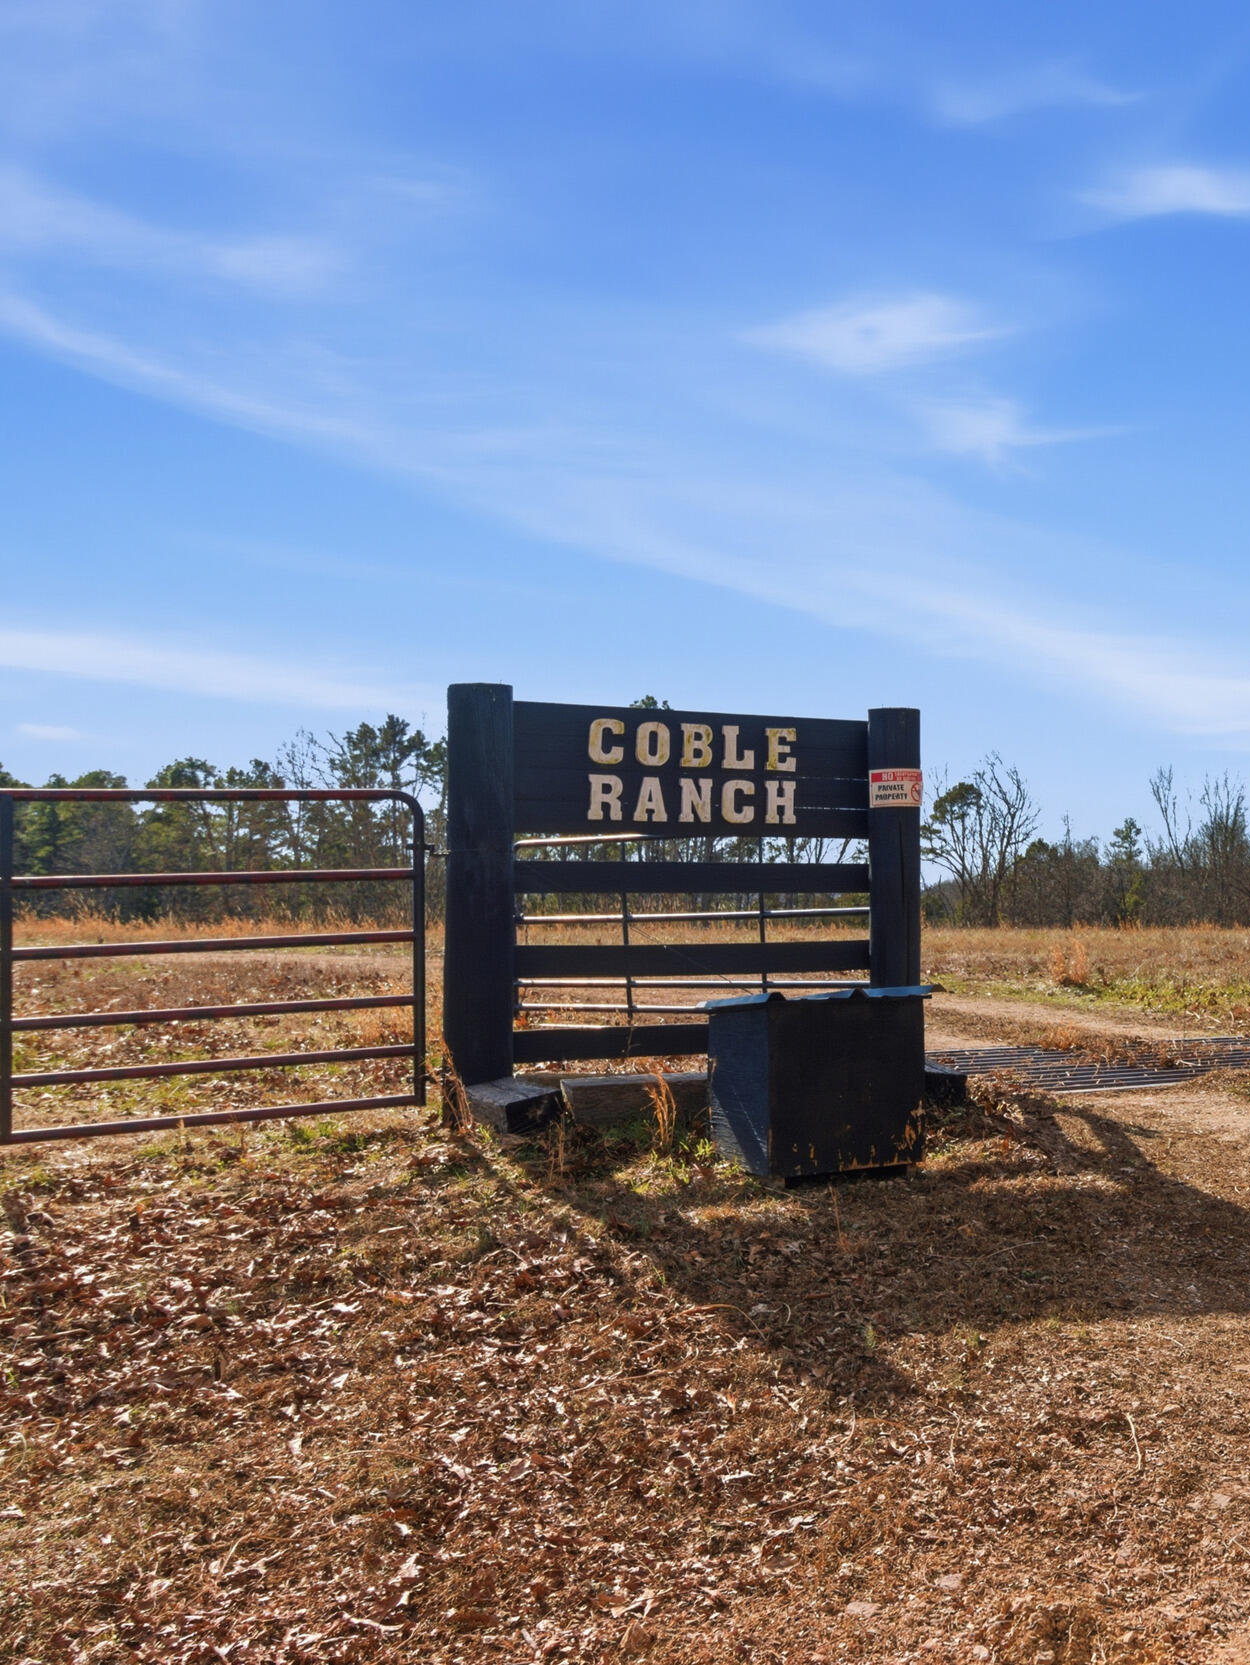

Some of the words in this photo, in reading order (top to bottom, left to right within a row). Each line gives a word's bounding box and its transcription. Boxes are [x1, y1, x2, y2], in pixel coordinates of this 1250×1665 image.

[588, 718, 797, 772] COBLE
[881, 772, 894, 781] NO
[878, 784, 905, 792] PRIVATE
[587, 773, 797, 825] RANCH
[875, 792, 908, 801] PROPERTY
